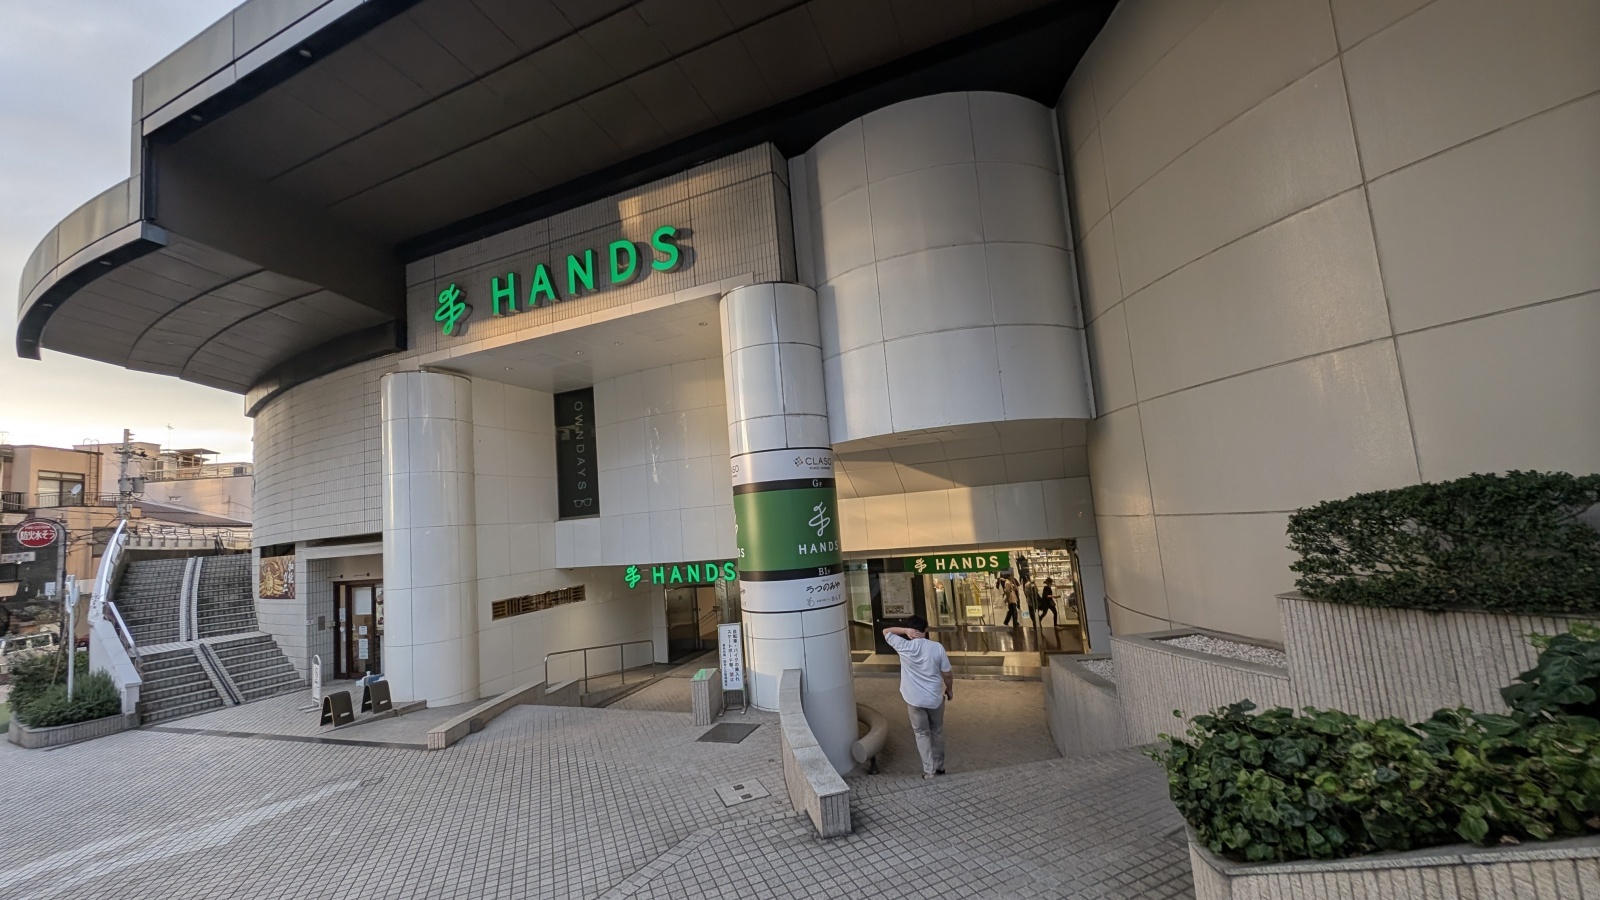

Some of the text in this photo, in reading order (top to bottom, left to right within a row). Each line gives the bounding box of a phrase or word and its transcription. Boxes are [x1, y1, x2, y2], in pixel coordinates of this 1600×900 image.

[491, 225, 681, 316] HANDS
[574, 401, 587, 490] OWNDAYS
[805, 456, 832, 466] CLASO
[20, 530, 55, 541] 防火水そう
[798, 540, 839, 555] HANDS
[935, 555, 999, 571] HANDS
[652, 562, 736, 585] HANDS
[805, 581, 841, 594] うつのみや
